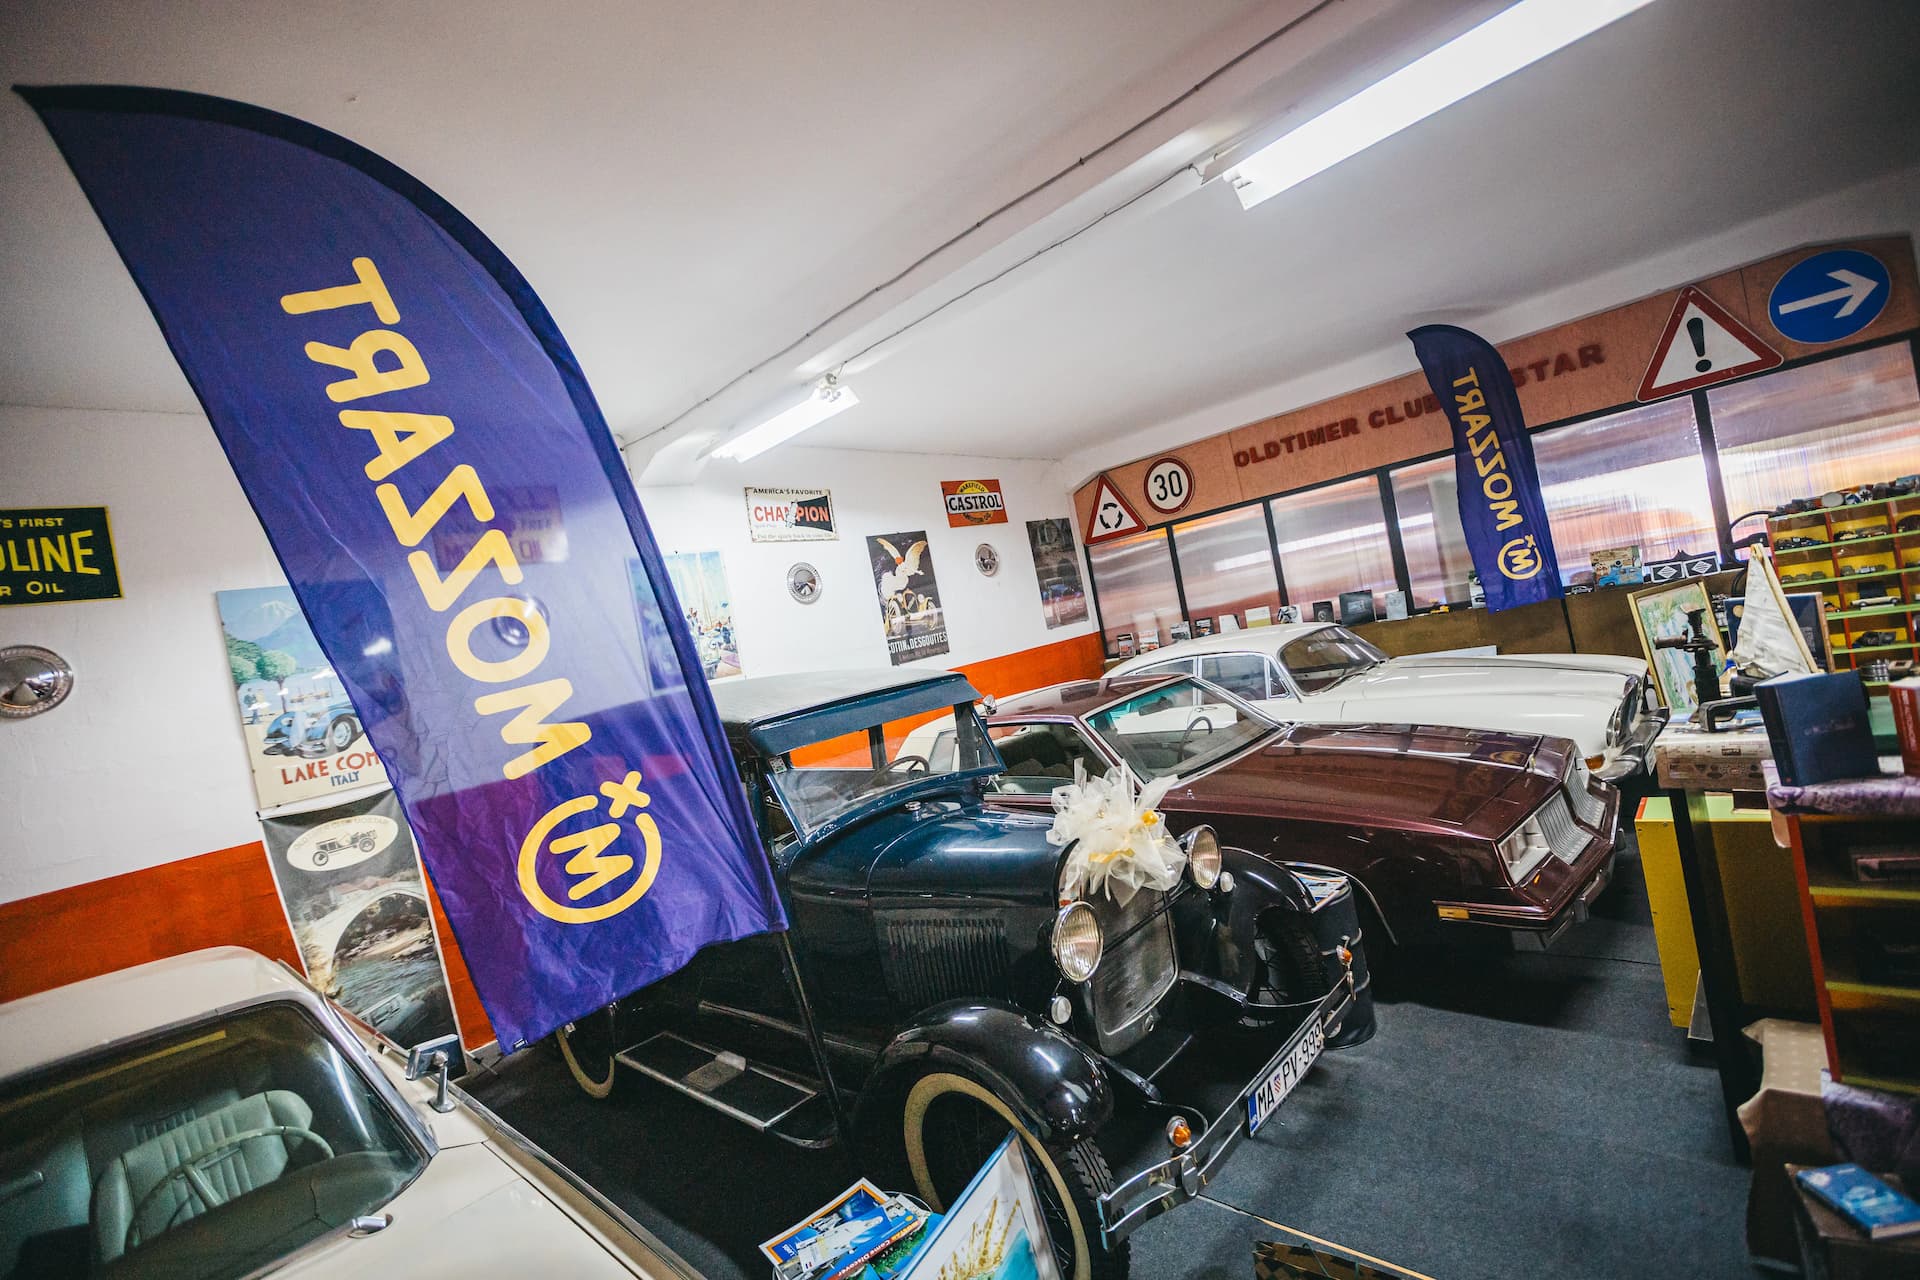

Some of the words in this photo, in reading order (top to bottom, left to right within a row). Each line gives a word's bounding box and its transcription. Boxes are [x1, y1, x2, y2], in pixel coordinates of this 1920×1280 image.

[1232, 417, 1361, 468] OLDTIMER
[1367, 393, 1442, 430] CLUB
[1509, 343, 1606, 389] STAR
[1153, 470, 1183, 501] 30
[948, 494, 1002, 511] CASTROL
[19, 517, 65, 528] FIRST
[0, 530, 101, 575] LINE
[281, 760, 330, 785] LAKE
[330, 770, 360, 787] ITALY
[1257, 1080, 1275, 1118] MA
[837, 1253, 870, 1277] Discover
